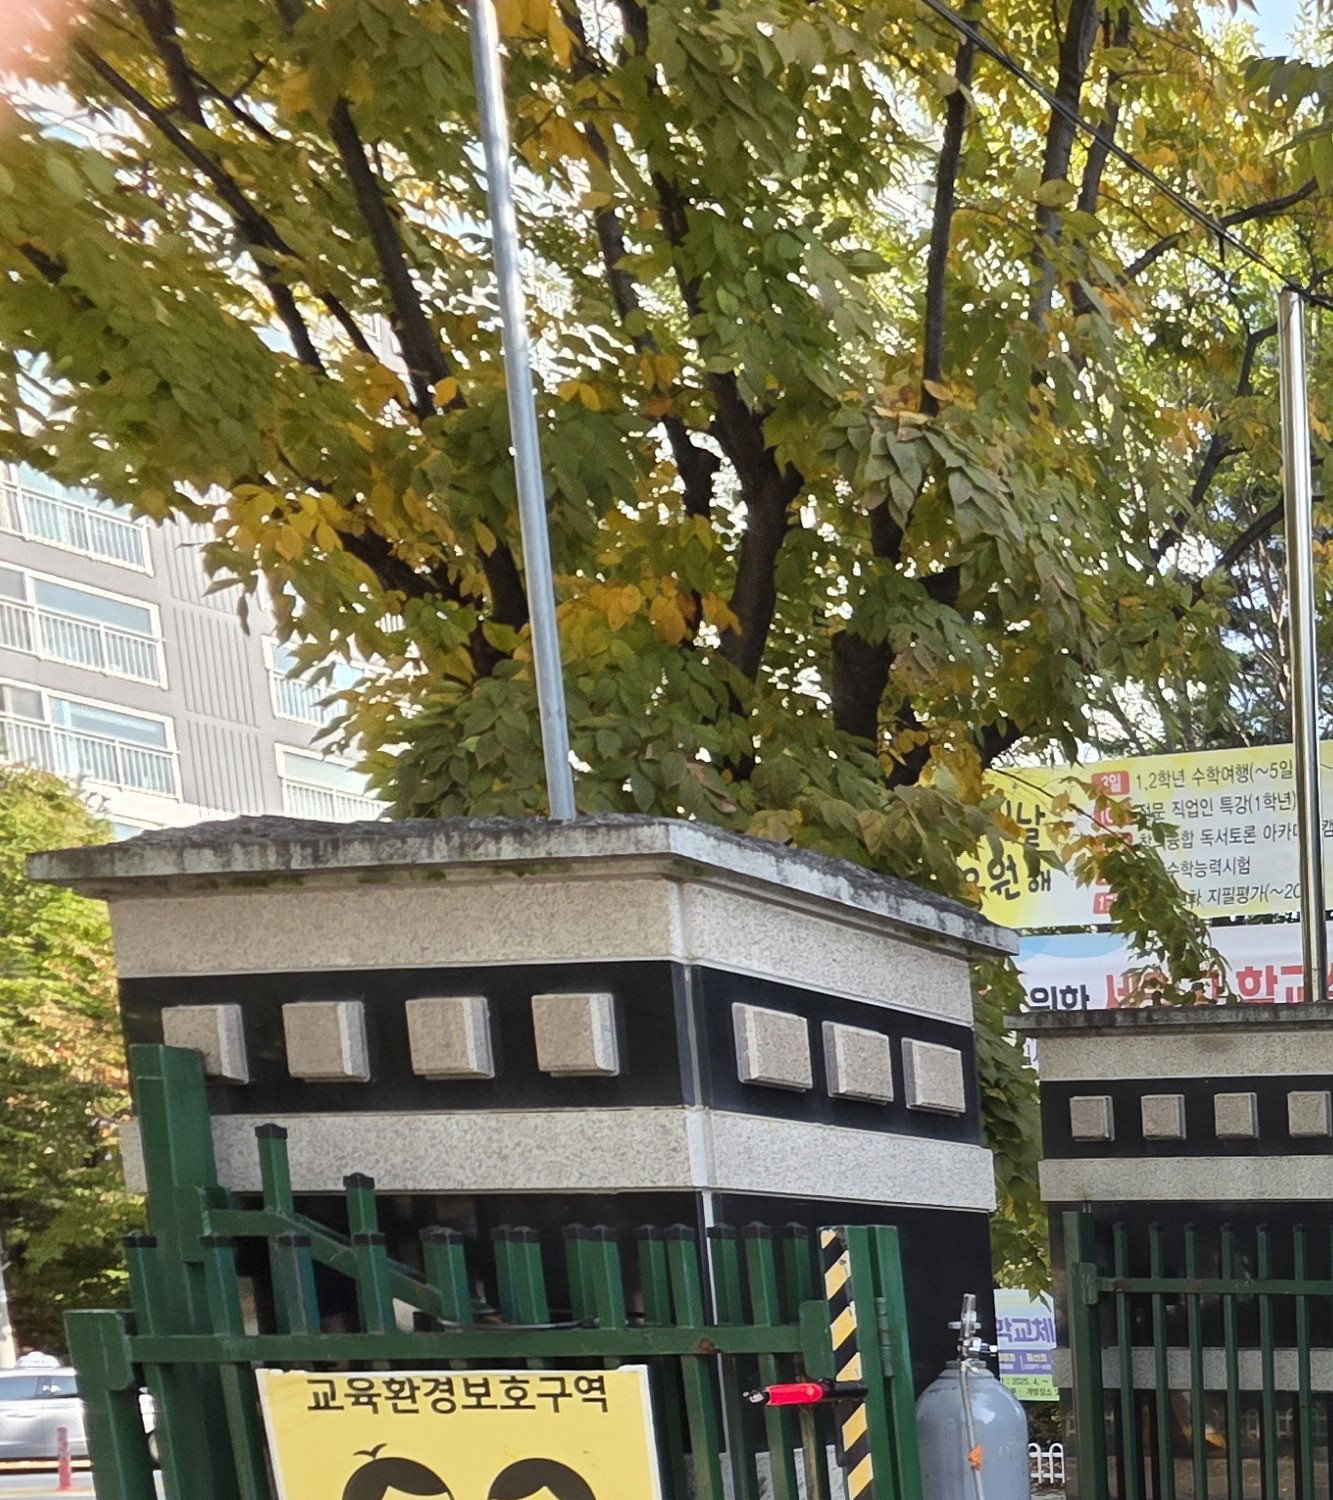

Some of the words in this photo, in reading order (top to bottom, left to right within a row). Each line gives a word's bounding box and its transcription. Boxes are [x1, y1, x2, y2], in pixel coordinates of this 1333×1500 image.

[1172, 797, 1214, 819] 직업인
[1200, 824, 1256, 847] 독서토론
[306, 1374, 609, 1415] 교육환경보호구역
